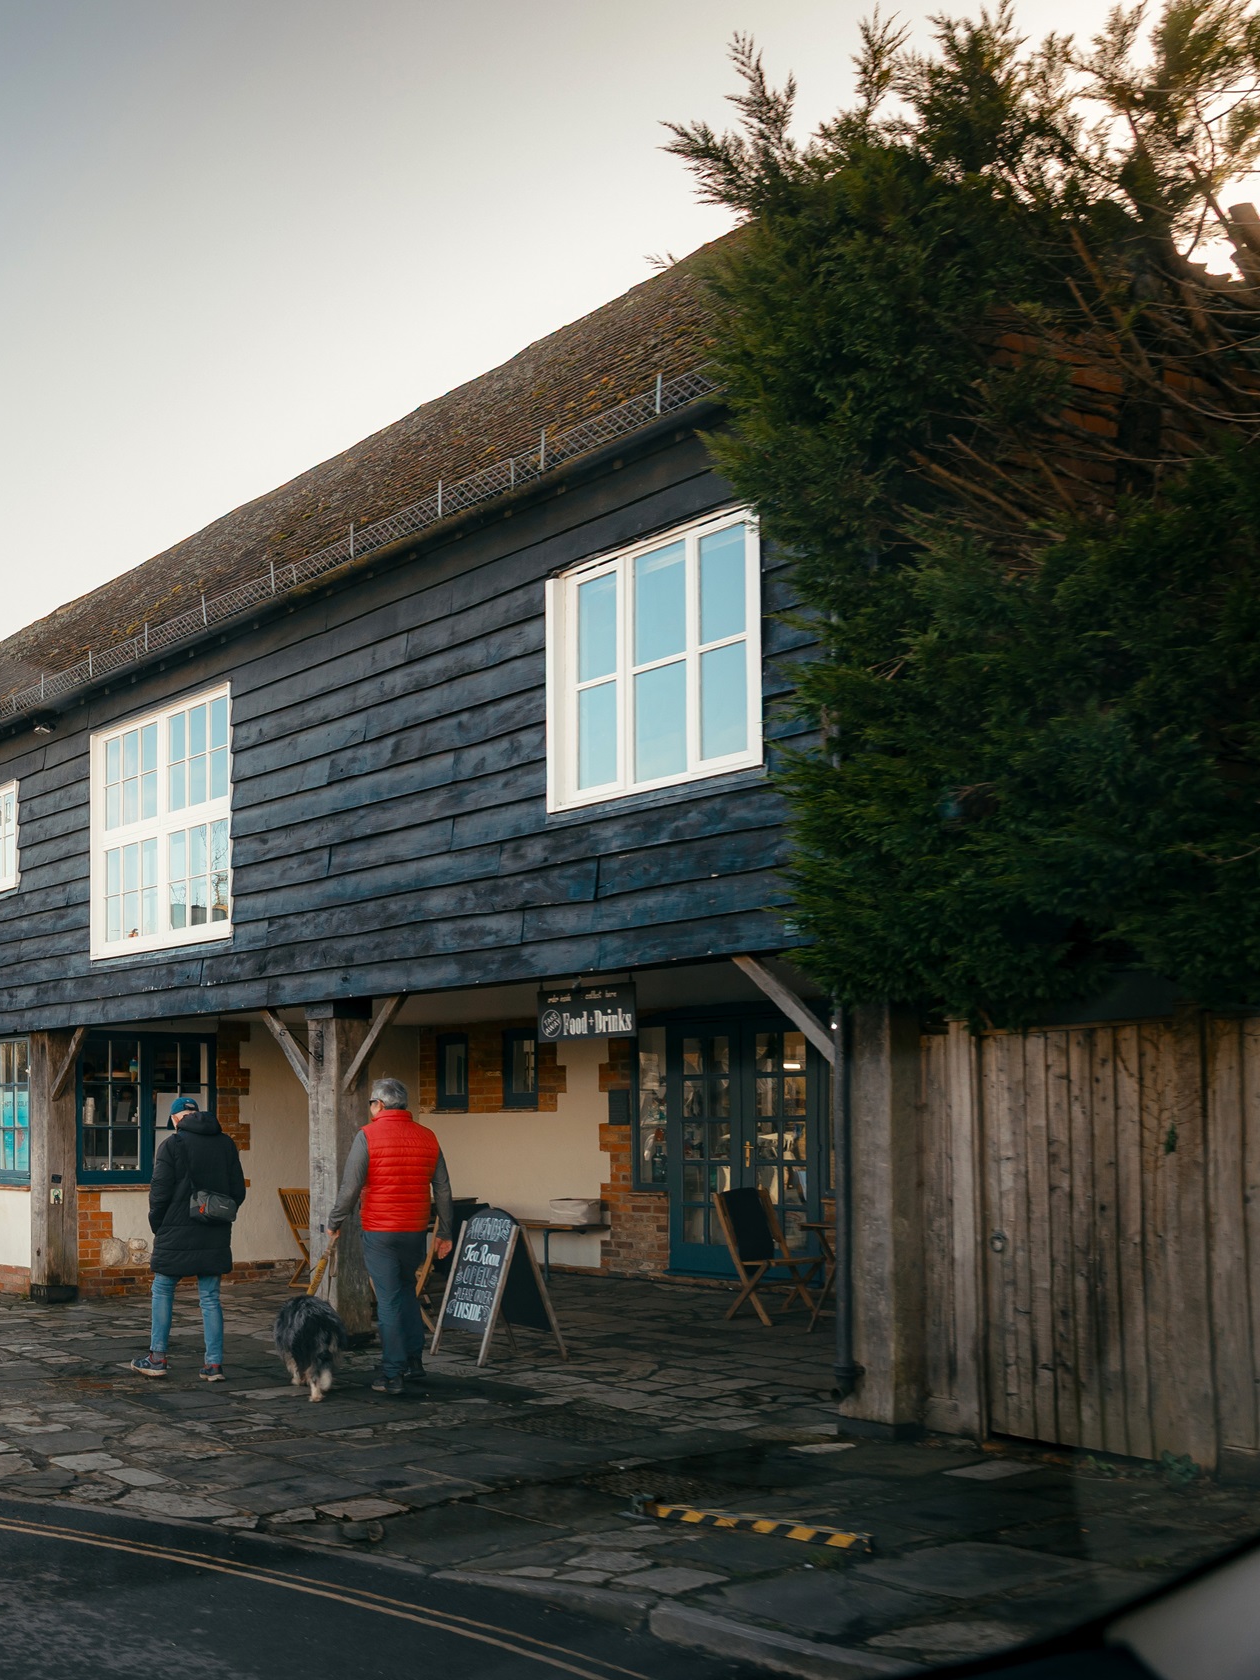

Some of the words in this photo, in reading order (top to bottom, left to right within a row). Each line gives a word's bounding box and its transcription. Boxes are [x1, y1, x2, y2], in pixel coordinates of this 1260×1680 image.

[543, 1012, 557, 1026] TAKE
[544, 1018, 561, 1034] AWAY
[562, 1010, 588, 1036] Food
[593, 1008, 632, 1033] Drinks
[462, 1242, 480, 1262] Tea
[479, 1244, 501, 1267] Room
[453, 1301, 484, 1321] INSIDE
